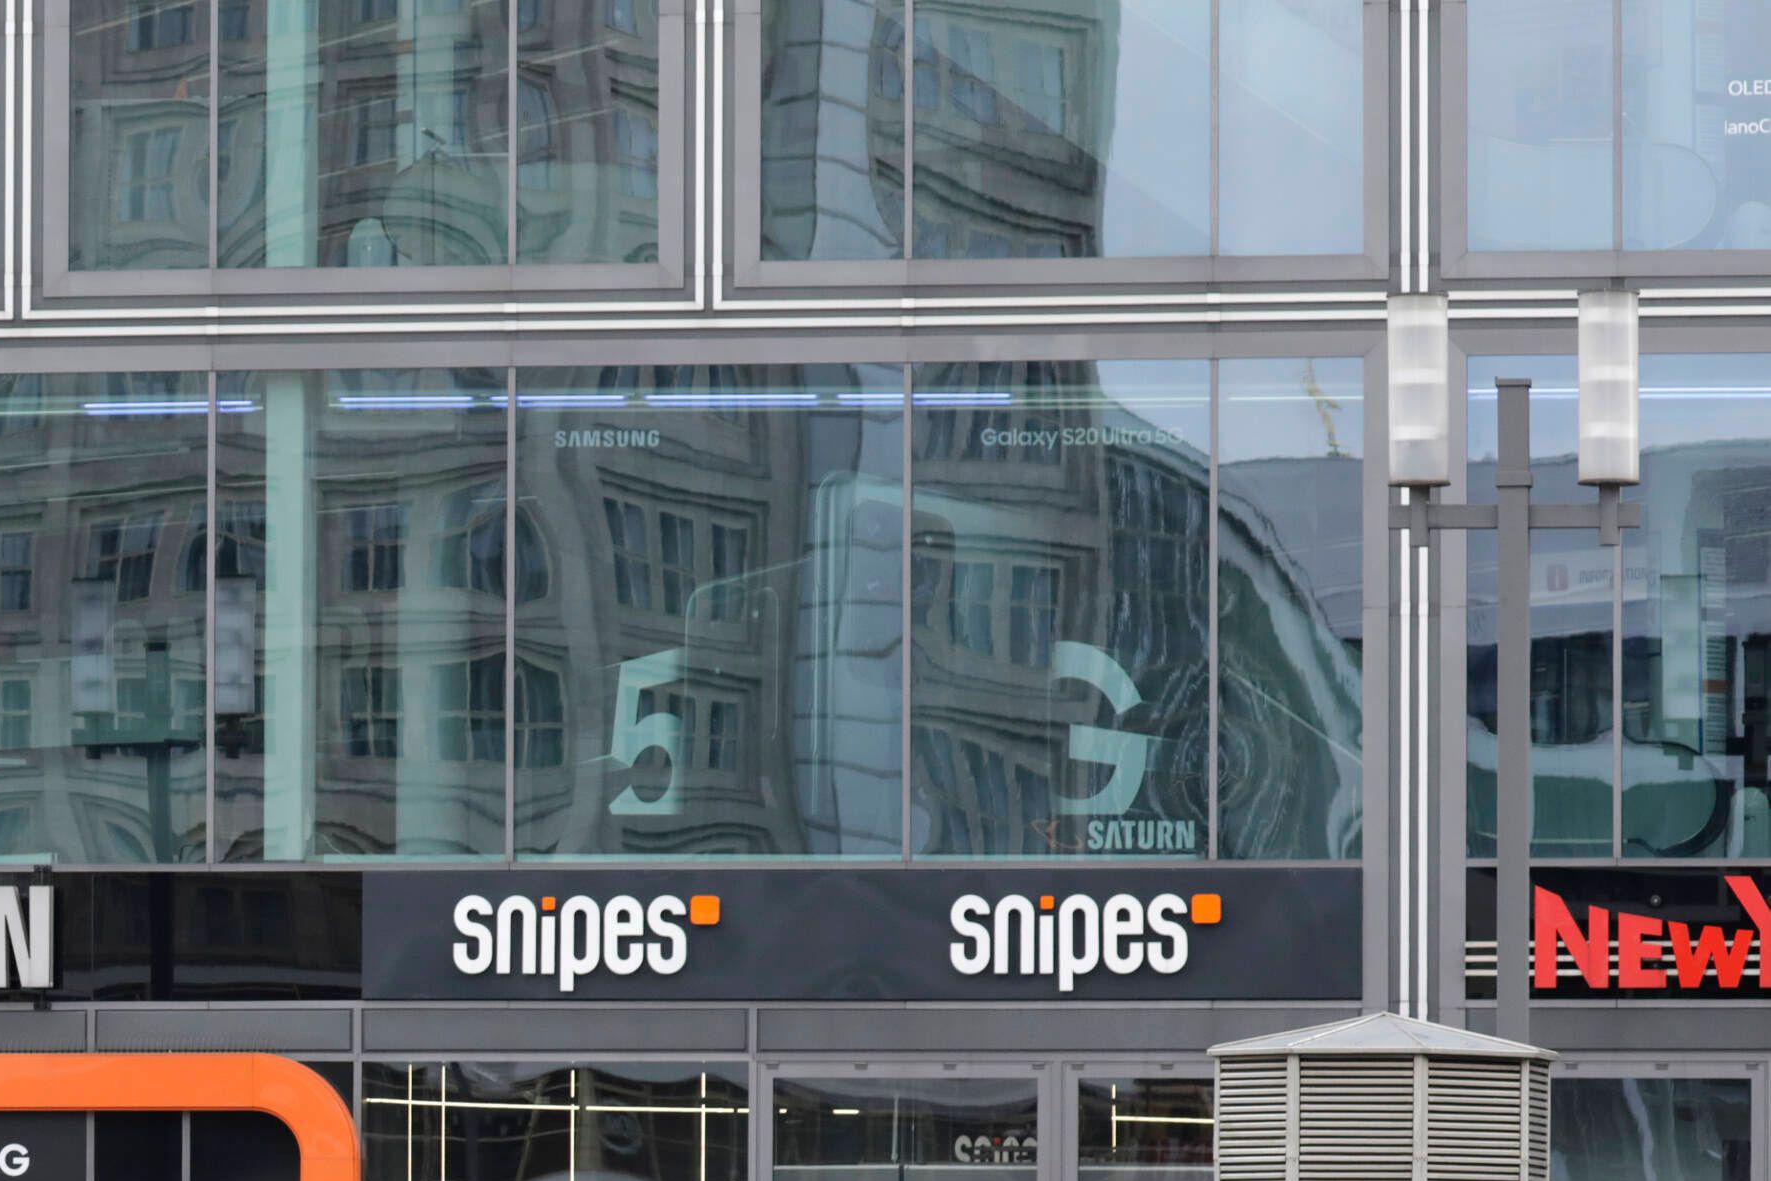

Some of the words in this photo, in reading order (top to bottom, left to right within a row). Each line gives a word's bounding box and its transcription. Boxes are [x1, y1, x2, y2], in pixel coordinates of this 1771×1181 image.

[555, 430, 660, 448] SAMSUNG
[980, 427, 1058, 449] Galaxy
[1062, 427, 1099, 446] S20
[1102, 426, 1152, 445] Ultra
[1155, 426, 1184, 445] 5G
[609, 647, 685, 815] 5
[1087, 820, 1196, 850] SATURN
[453, 894, 688, 992] snipes
[950, 893, 1189, 992] snipes
